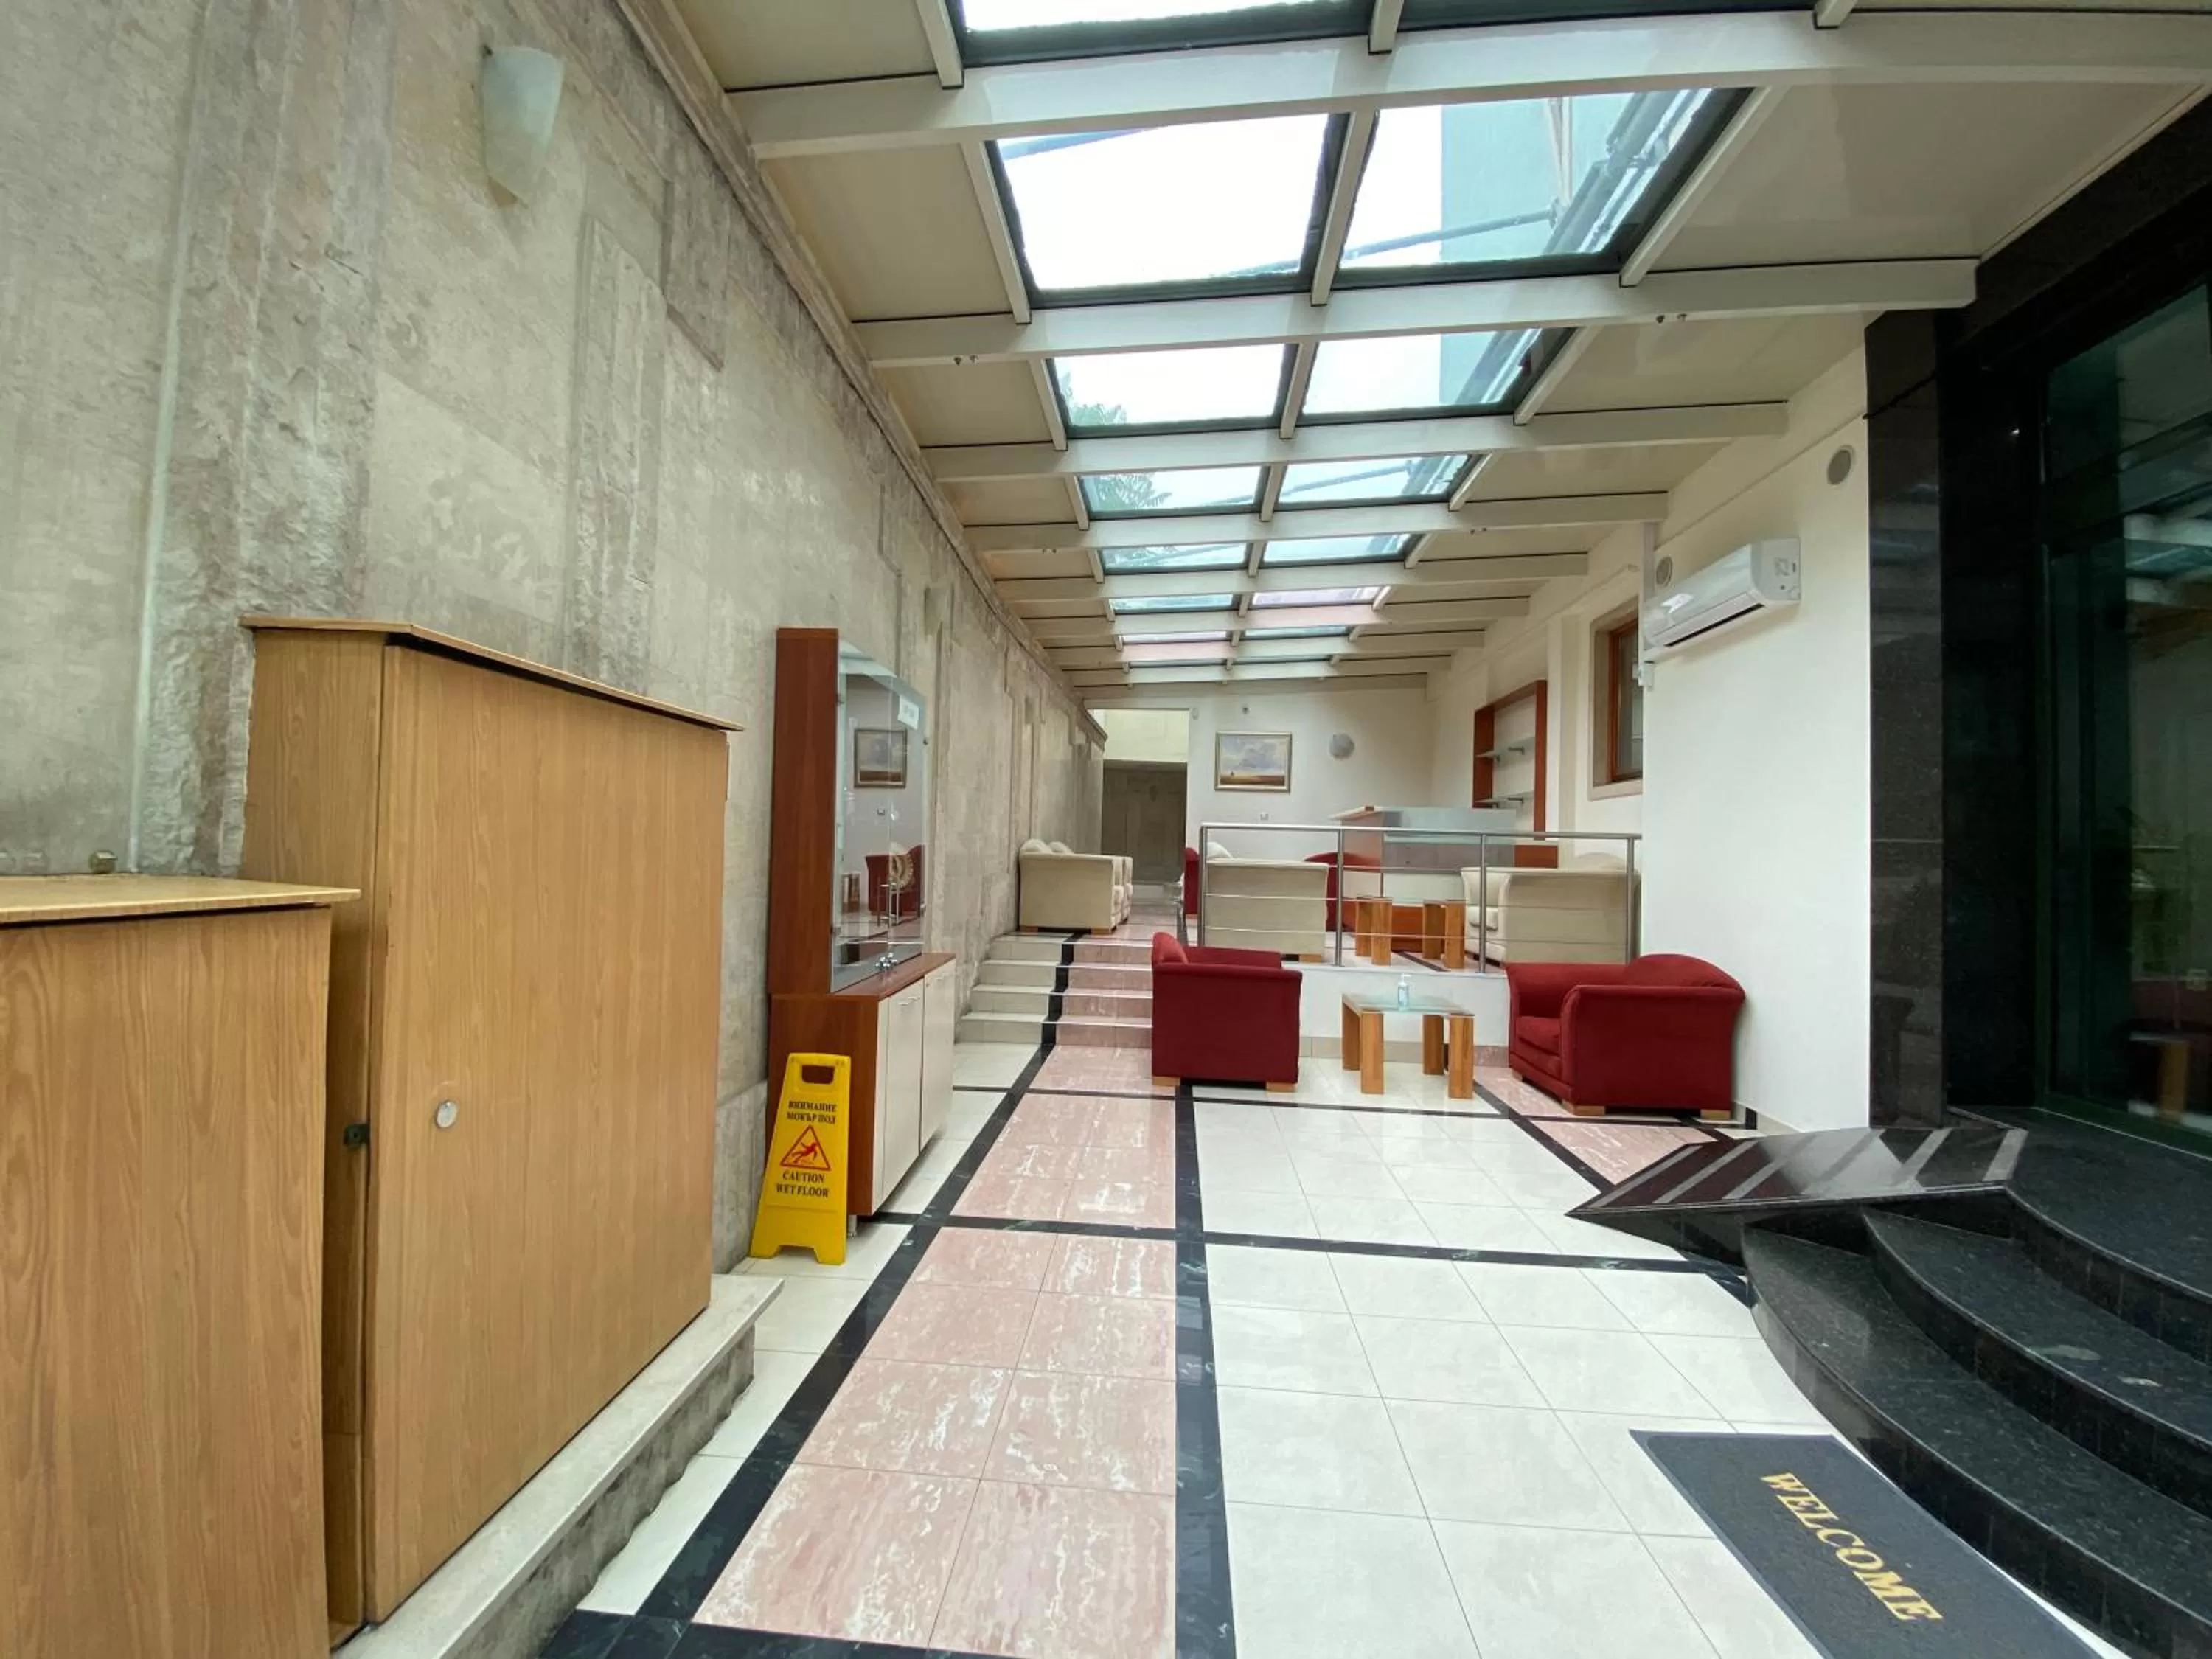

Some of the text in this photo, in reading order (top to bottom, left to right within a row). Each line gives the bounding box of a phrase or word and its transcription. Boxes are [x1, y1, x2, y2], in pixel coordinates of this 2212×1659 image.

[782, 1171, 824, 1183] CAUTION
[776, 1183, 829, 1197] WET FLOOR
[1760, 1472, 1944, 1620] WELCOME
